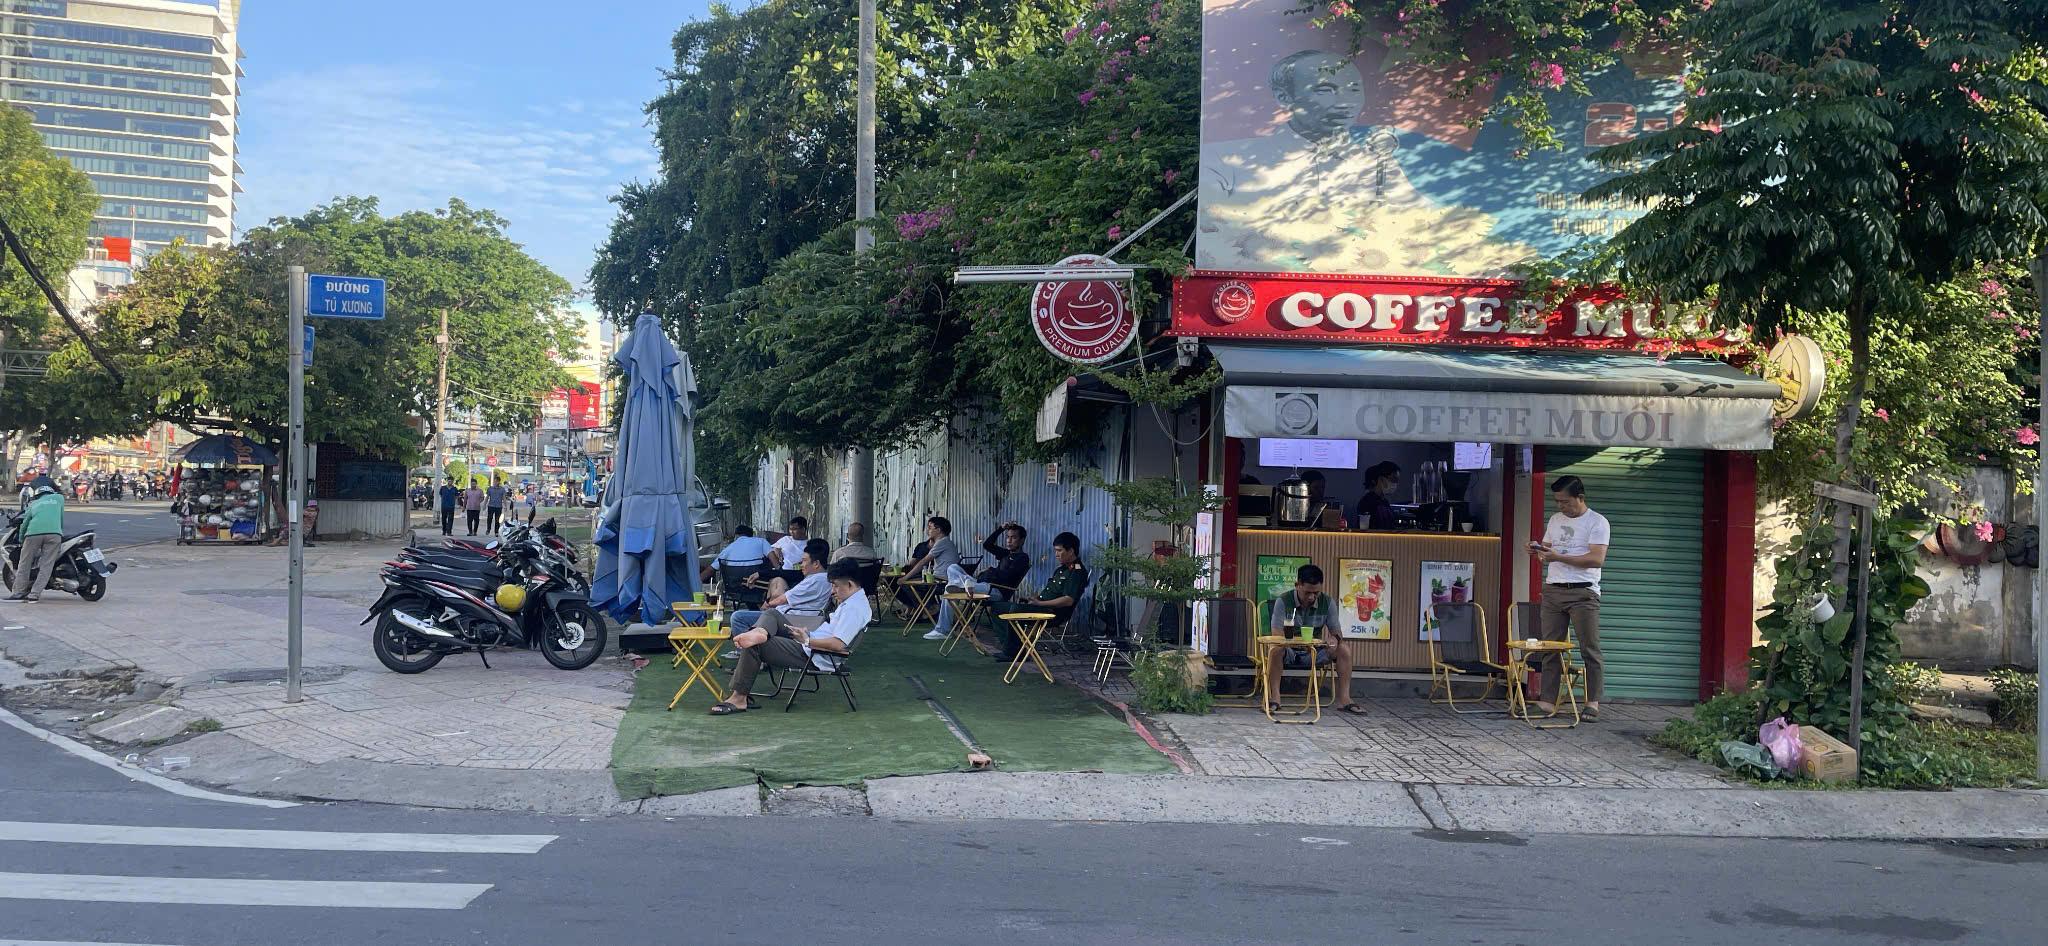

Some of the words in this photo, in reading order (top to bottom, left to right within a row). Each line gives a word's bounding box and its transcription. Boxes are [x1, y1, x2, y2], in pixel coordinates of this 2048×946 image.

[326, 281, 370, 294] ĐƯỜNG
[341, 301, 373, 314] XƯƠNG
[1281, 291, 1548, 335] COFFEE
[1045, 328, 1090, 357] PREMIUM
[1094, 320, 1131, 355] QUALITY
[1355, 404, 1531, 437] COFFEE
[1544, 397, 1674, 442] MUỐI
[1351, 625, 1367, 634] 25k
